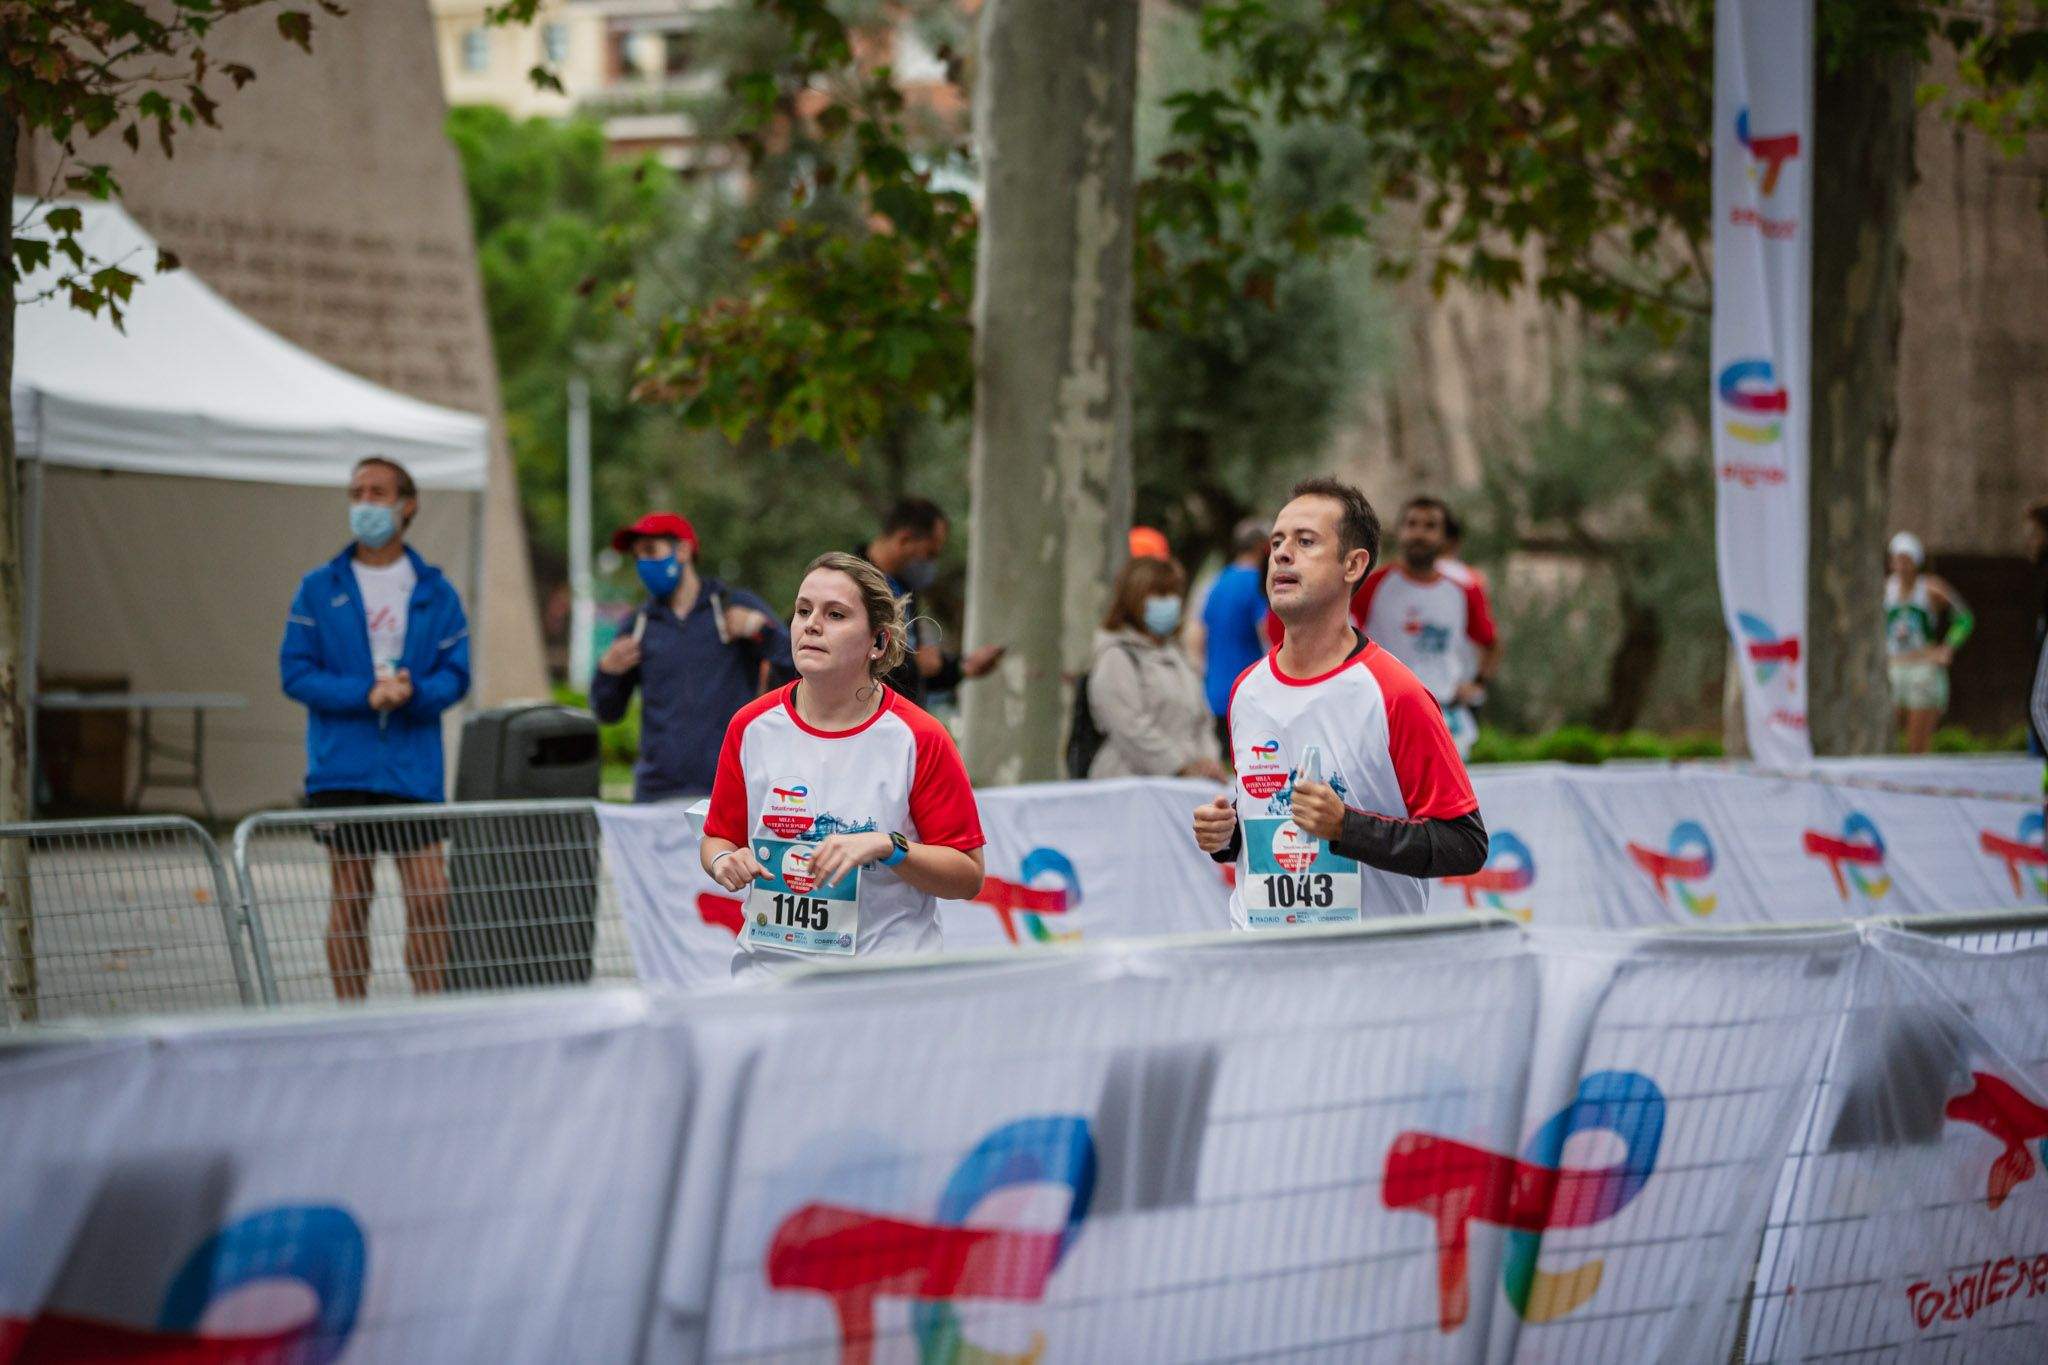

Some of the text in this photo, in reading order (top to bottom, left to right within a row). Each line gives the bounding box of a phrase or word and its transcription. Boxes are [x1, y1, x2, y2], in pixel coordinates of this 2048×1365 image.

[771, 805, 807, 813] TotalEnergies
[1263, 874, 1334, 908] 1043
[773, 893, 829, 931] 1145
[757, 930, 780, 939] MADRID
